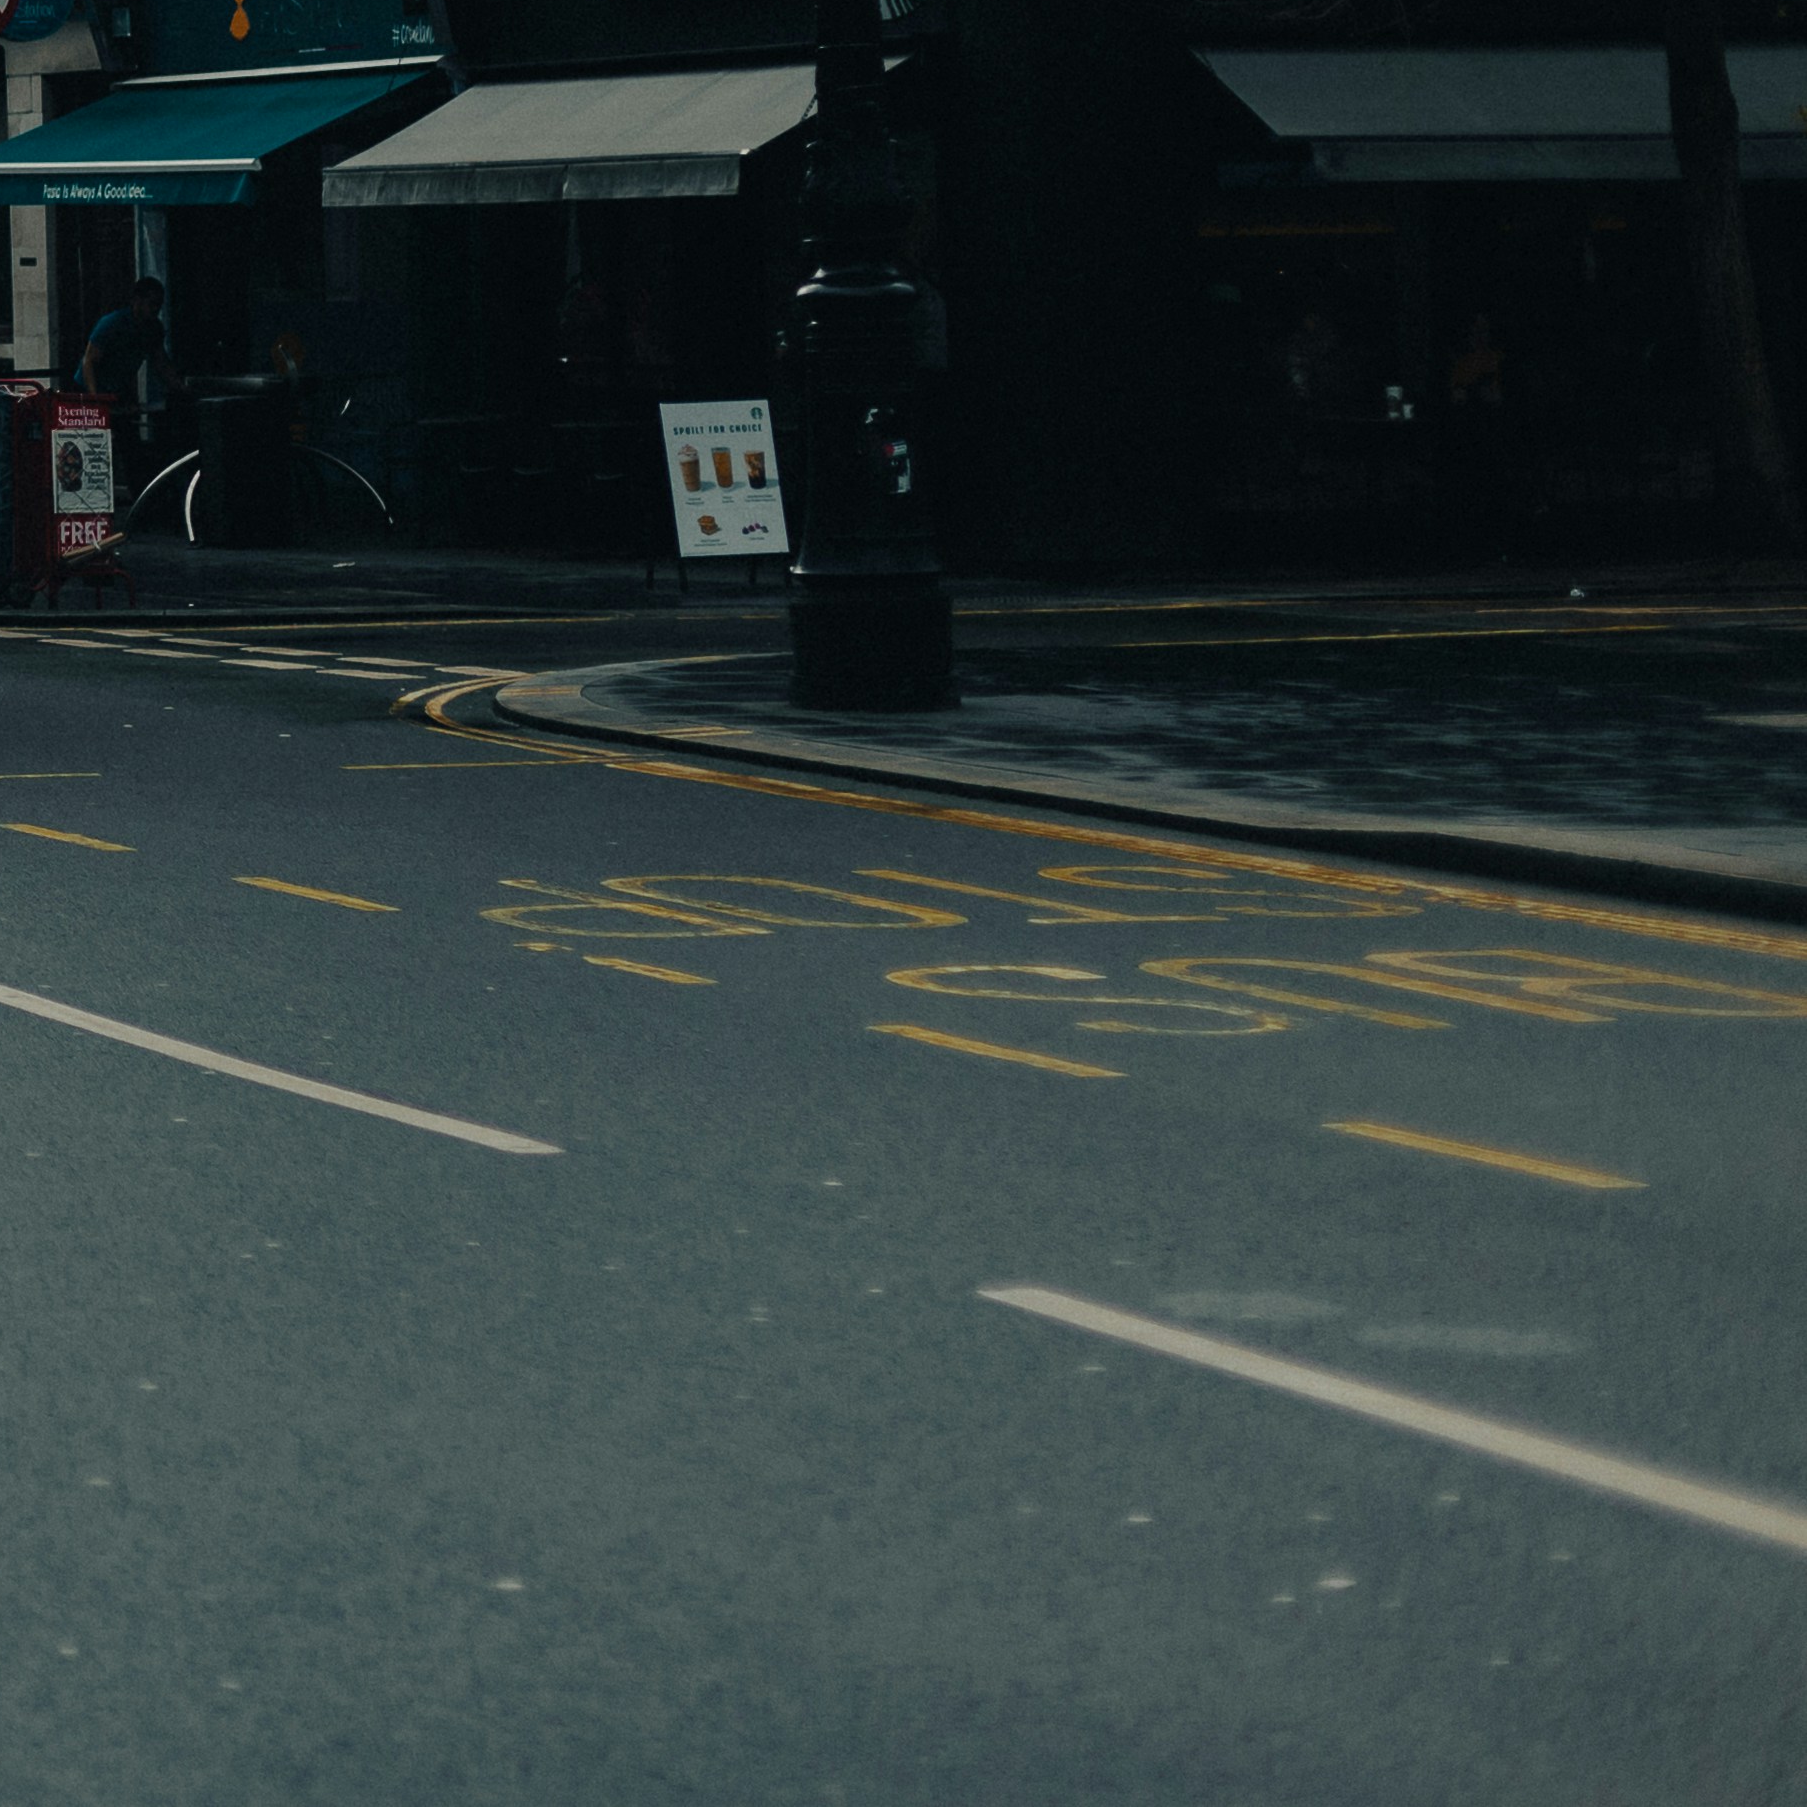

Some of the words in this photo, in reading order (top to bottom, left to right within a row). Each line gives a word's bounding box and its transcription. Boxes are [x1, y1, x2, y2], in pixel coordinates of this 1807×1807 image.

[69, 183, 96, 203] Always
[58, 406, 99, 418] Evening
[58, 416, 106, 427] Standard
[673, 426, 704, 436] SPOILT
[708, 425, 725, 434] FOR
[729, 423, 762, 433] CHOICE
